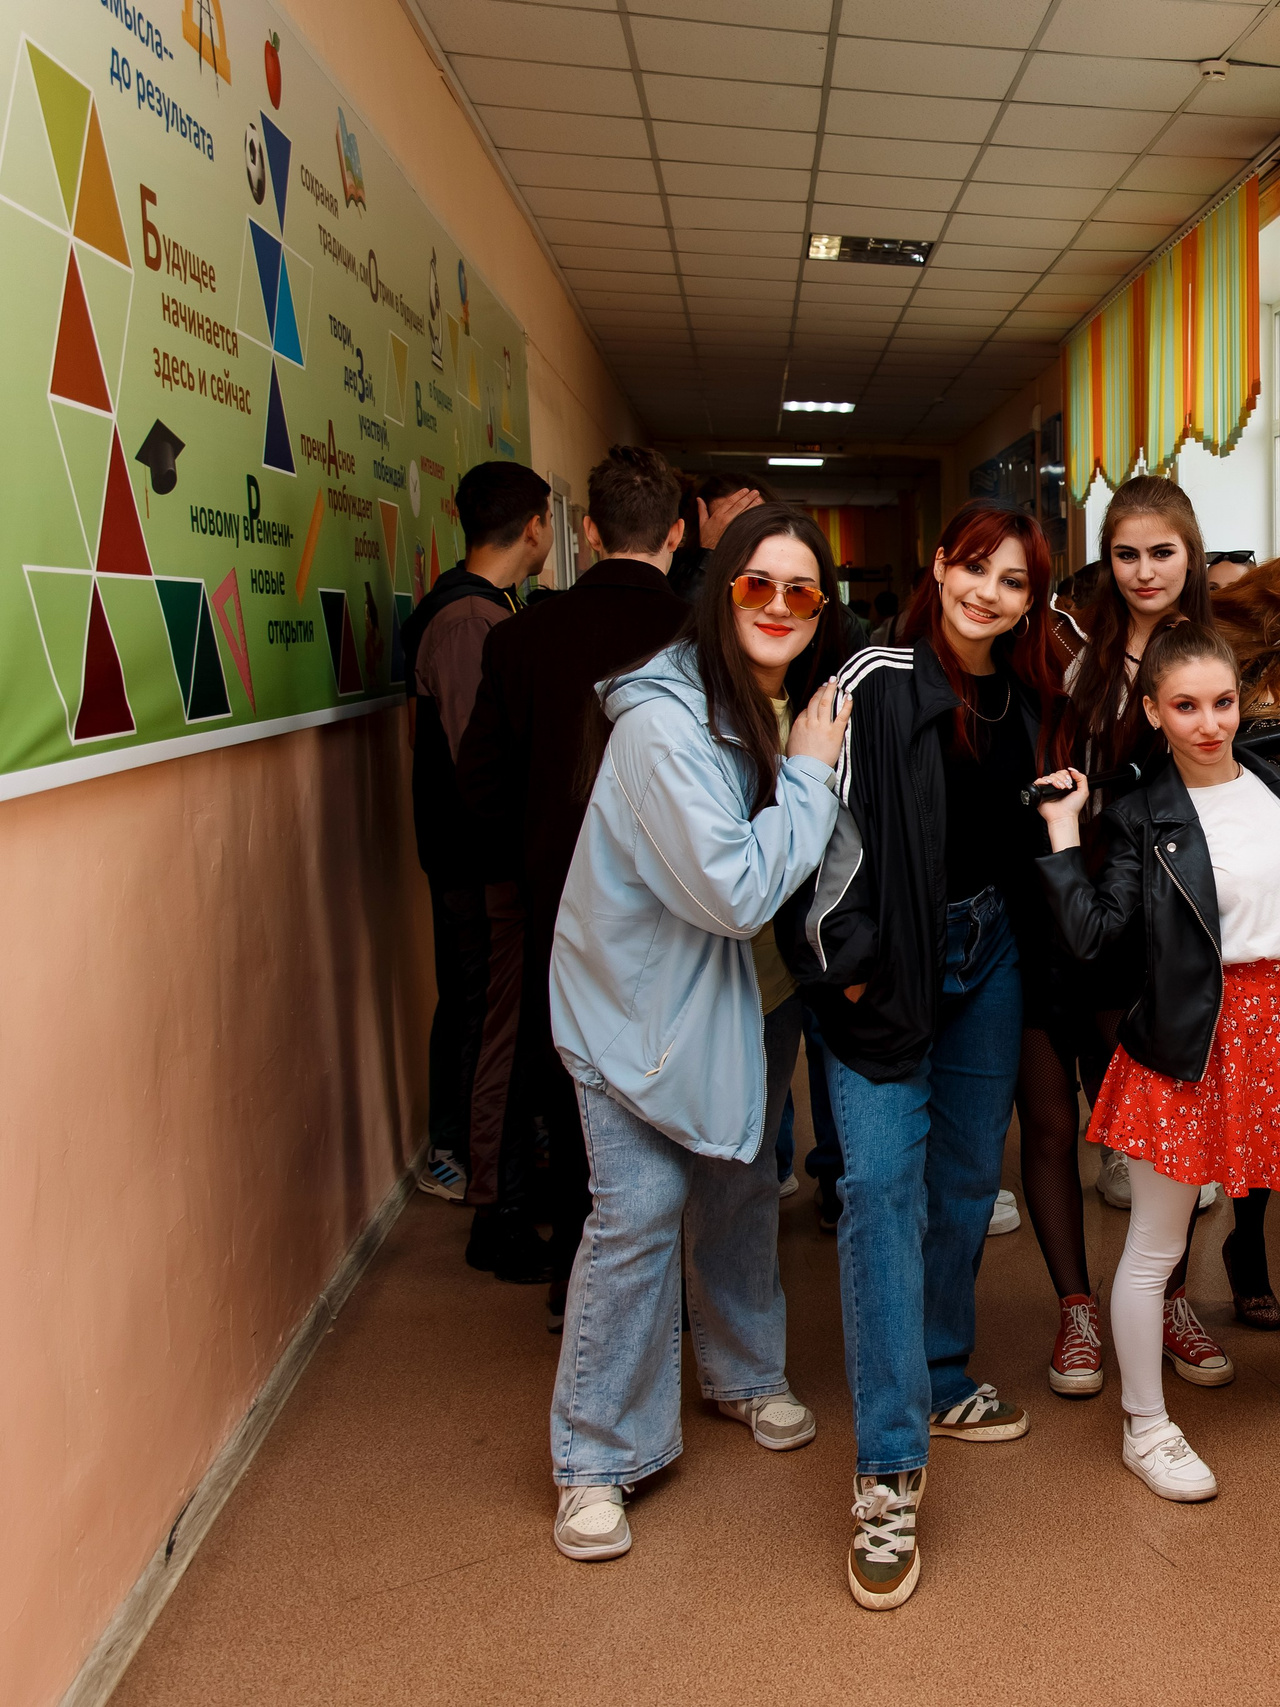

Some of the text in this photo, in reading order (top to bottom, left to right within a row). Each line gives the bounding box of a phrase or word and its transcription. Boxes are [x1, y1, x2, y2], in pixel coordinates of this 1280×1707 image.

[101, 0, 174, 61] мысла--
[110, 47, 214, 162] до результата
[300, 164, 340, 220] сохраняя
[140, 183, 216, 293] Будущее
[318, 224, 359, 282] традиции,
[161, 292, 239, 358] начинается
[328, 313, 355, 355] твори,
[153, 347, 252, 415] здесь и сейчас
[300, 419, 356, 479] прекрАсное
[190, 504, 240, 548] новому
[328, 484, 373, 520] пробуждает
[354, 531, 380, 565] доброе
[250, 568, 285, 596] новые
[268, 620, 315, 651] открытия
